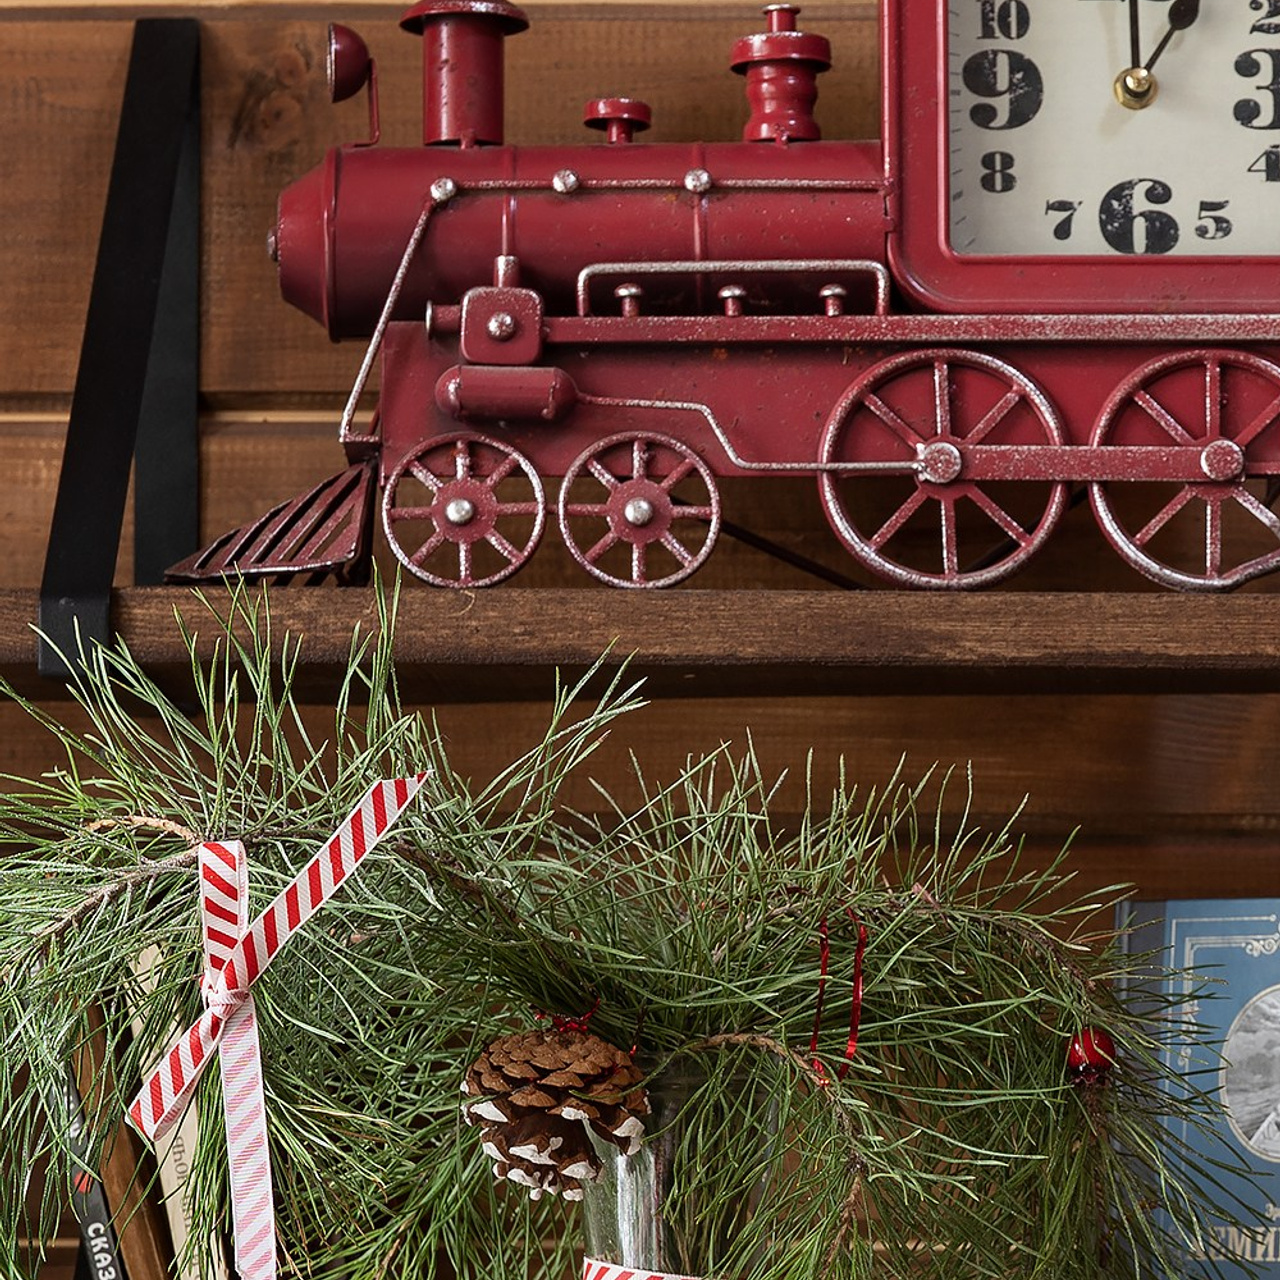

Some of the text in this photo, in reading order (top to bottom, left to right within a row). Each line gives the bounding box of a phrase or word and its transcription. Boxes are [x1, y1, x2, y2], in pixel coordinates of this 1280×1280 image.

[976, 0, 1030, 40] 10
[962, 49, 1043, 131] 9
[979, 151, 1017, 193] 8
[1045, 200, 1083, 240] 7
[1099, 178, 1180, 255] 6
[1195, 200, 1232, 239] 5
